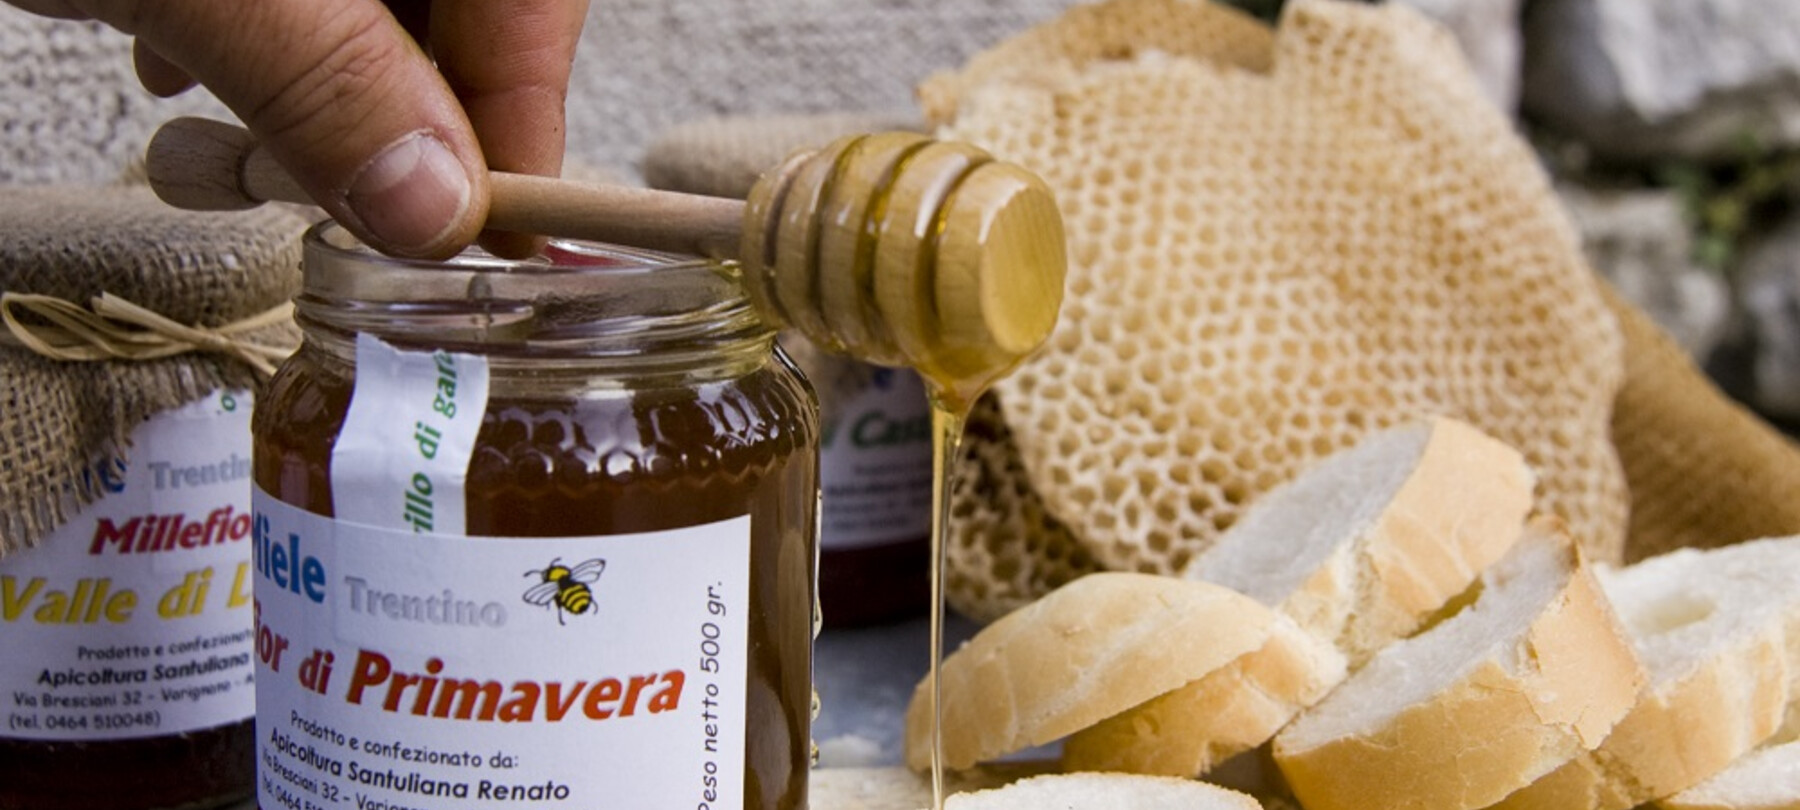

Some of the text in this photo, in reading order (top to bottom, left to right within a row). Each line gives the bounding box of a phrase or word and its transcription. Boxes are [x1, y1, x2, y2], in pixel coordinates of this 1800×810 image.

[414, 422, 442, 460] di
[404, 472, 433, 533] illo
[0, 575, 138, 624] Valle
[157, 566, 214, 619] di
[344, 574, 507, 628] Trentino
[707, 580, 726, 617] gr.
[37, 652, 249, 689] Apicoltura Santuliana
[78, 645, 150, 661] Prodotto
[154, 645, 163, 656] e
[700, 622, 721, 674] 500
[14, 691, 37, 708] Via
[42, 691, 116, 708] Bresciani
[123, 691, 142, 706] 32
[161, 680, 231, 702] Varignano
[299, 649, 335, 696] di
[345, 648, 686, 723] Primavera
[46, 714, 88, 730] 0464
[93, 709, 161, 731] 510048)
[291, 709, 519, 769] Prodotto e confezionato da:
[701, 683, 720, 752] netto
[270, 727, 570, 801] Apicoltura Santuliana Renato
[273, 754, 318, 793] Bresciani
[321, 782, 344, 803] 32
